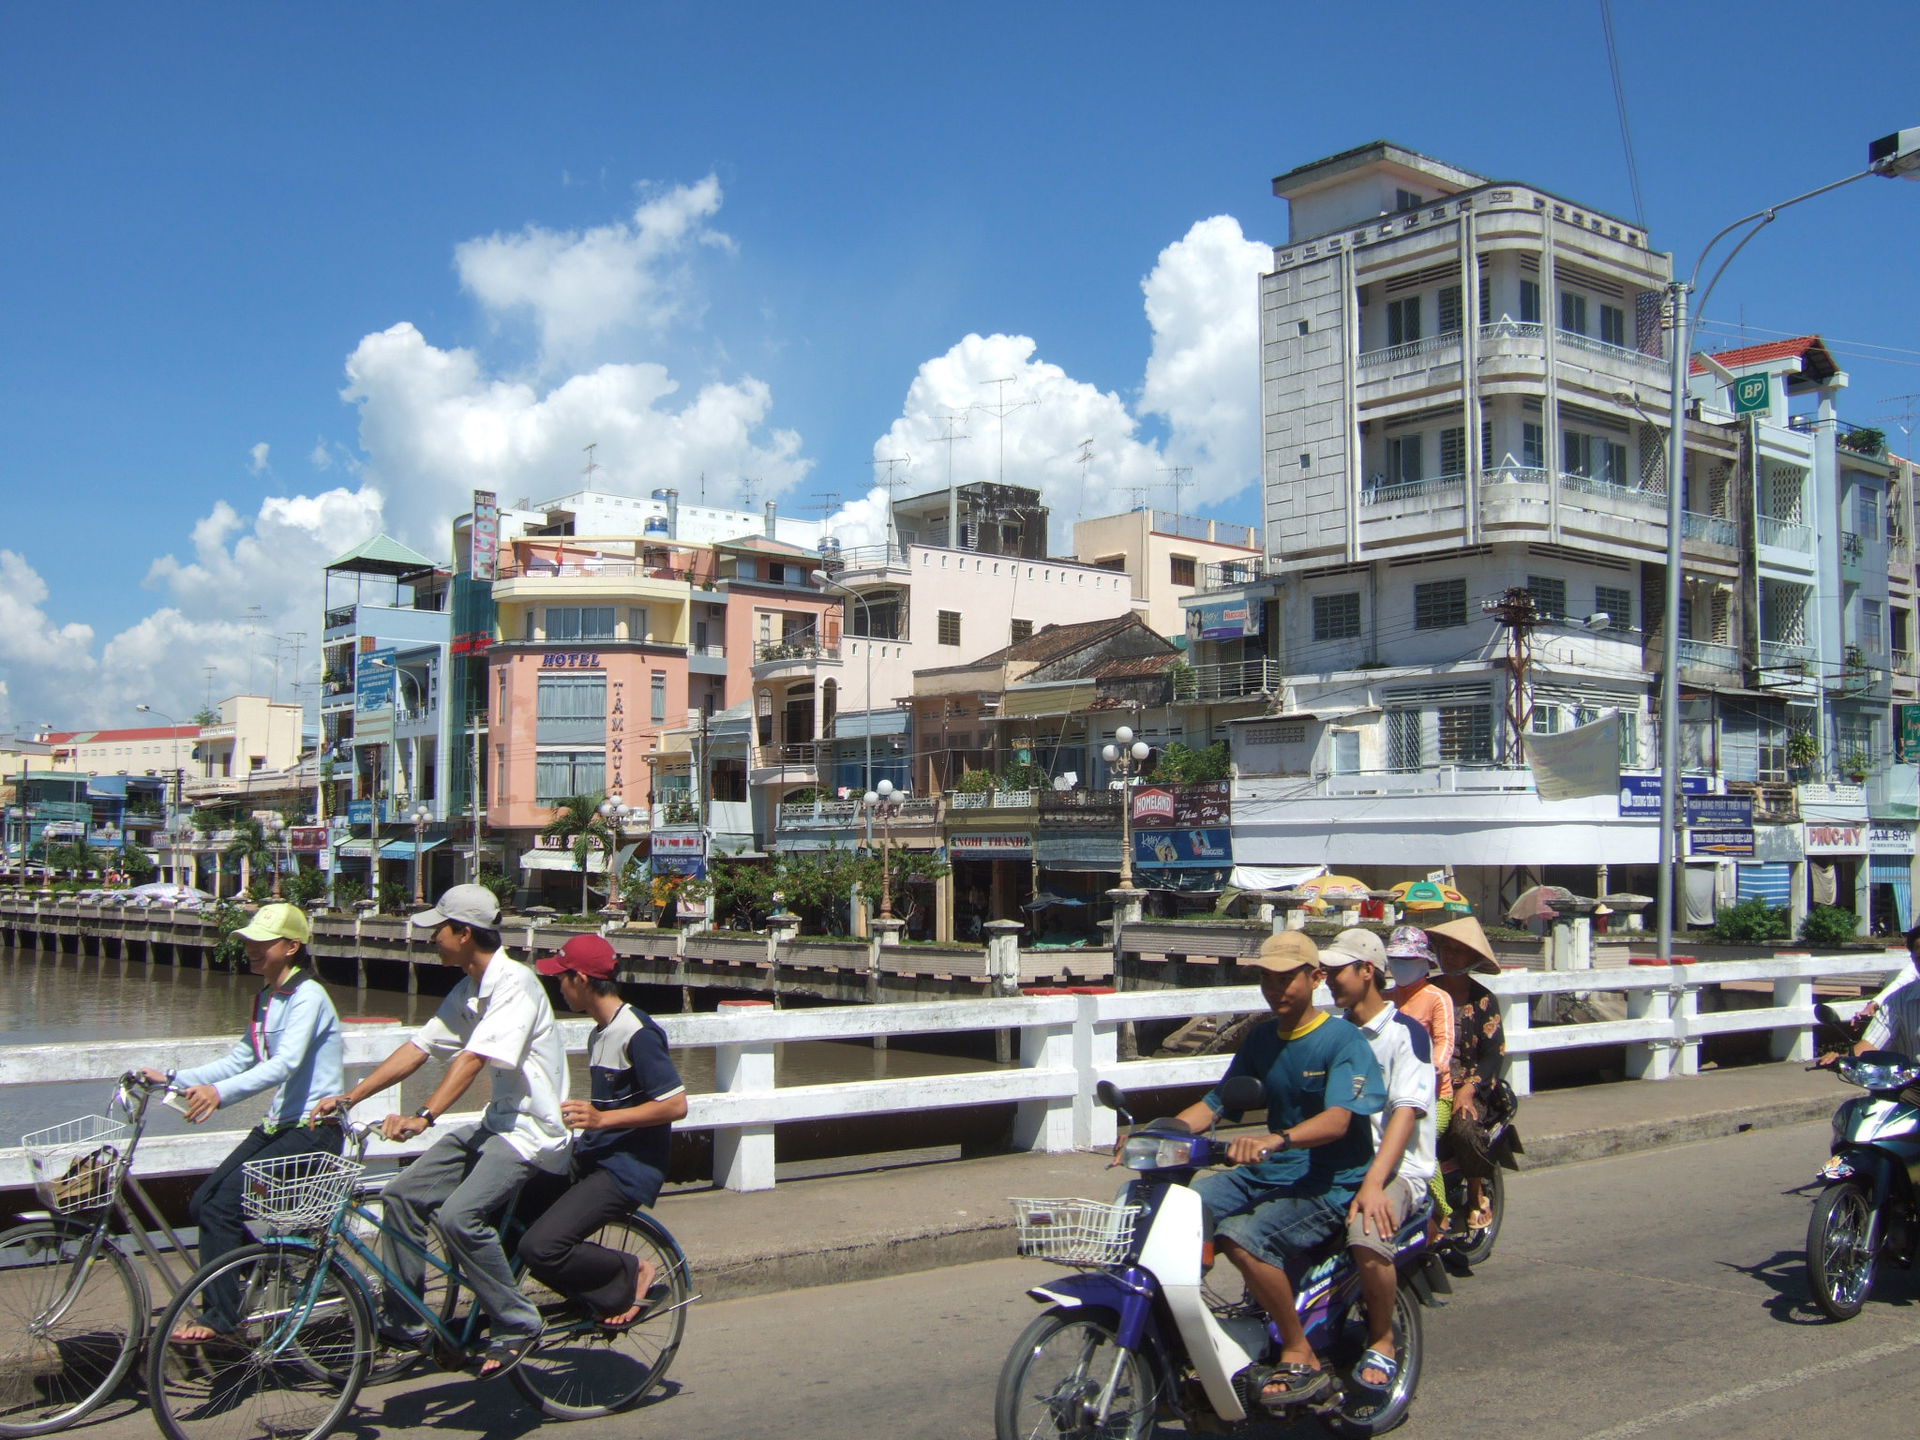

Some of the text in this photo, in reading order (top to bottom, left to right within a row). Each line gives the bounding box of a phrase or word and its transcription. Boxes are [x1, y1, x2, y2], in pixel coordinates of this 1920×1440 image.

[1744, 383, 1763, 399] BP
[476, 505, 495, 580] HOTEL
[542, 652, 600, 667] HOTEL
[1136, 795, 1170, 814] HOMELAND
